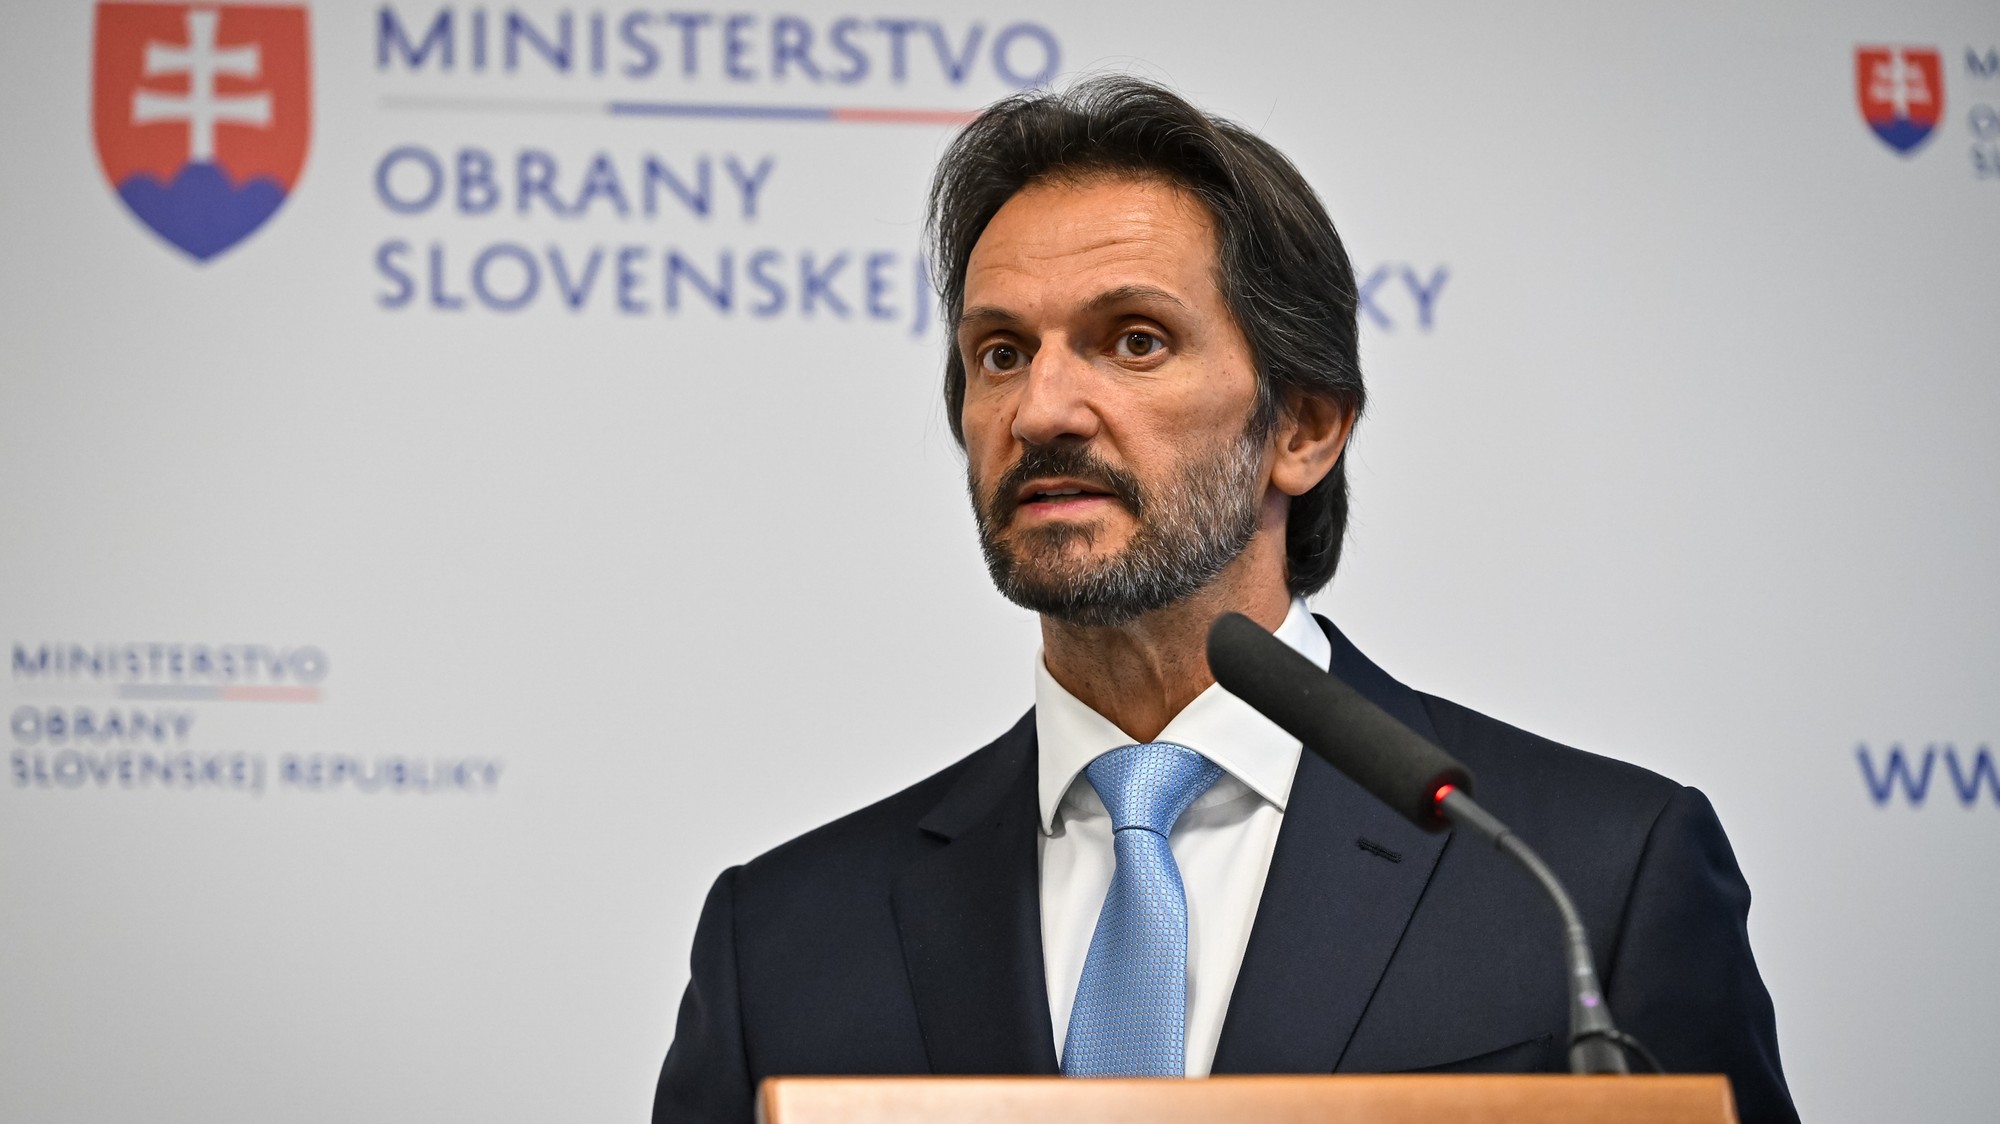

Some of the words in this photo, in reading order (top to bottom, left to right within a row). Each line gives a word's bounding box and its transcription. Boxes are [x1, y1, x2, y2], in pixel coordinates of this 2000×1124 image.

[374, 3, 1063, 87] MINISTERSTVO
[373, 144, 776, 220] OBRANY
[373, 239, 930, 336] SLOVENSKEJ
[11, 641, 328, 682] MINISTERSTVO
[10, 705, 192, 745] OBRANY
[9, 748, 265, 797] SLOVENSKEJ
